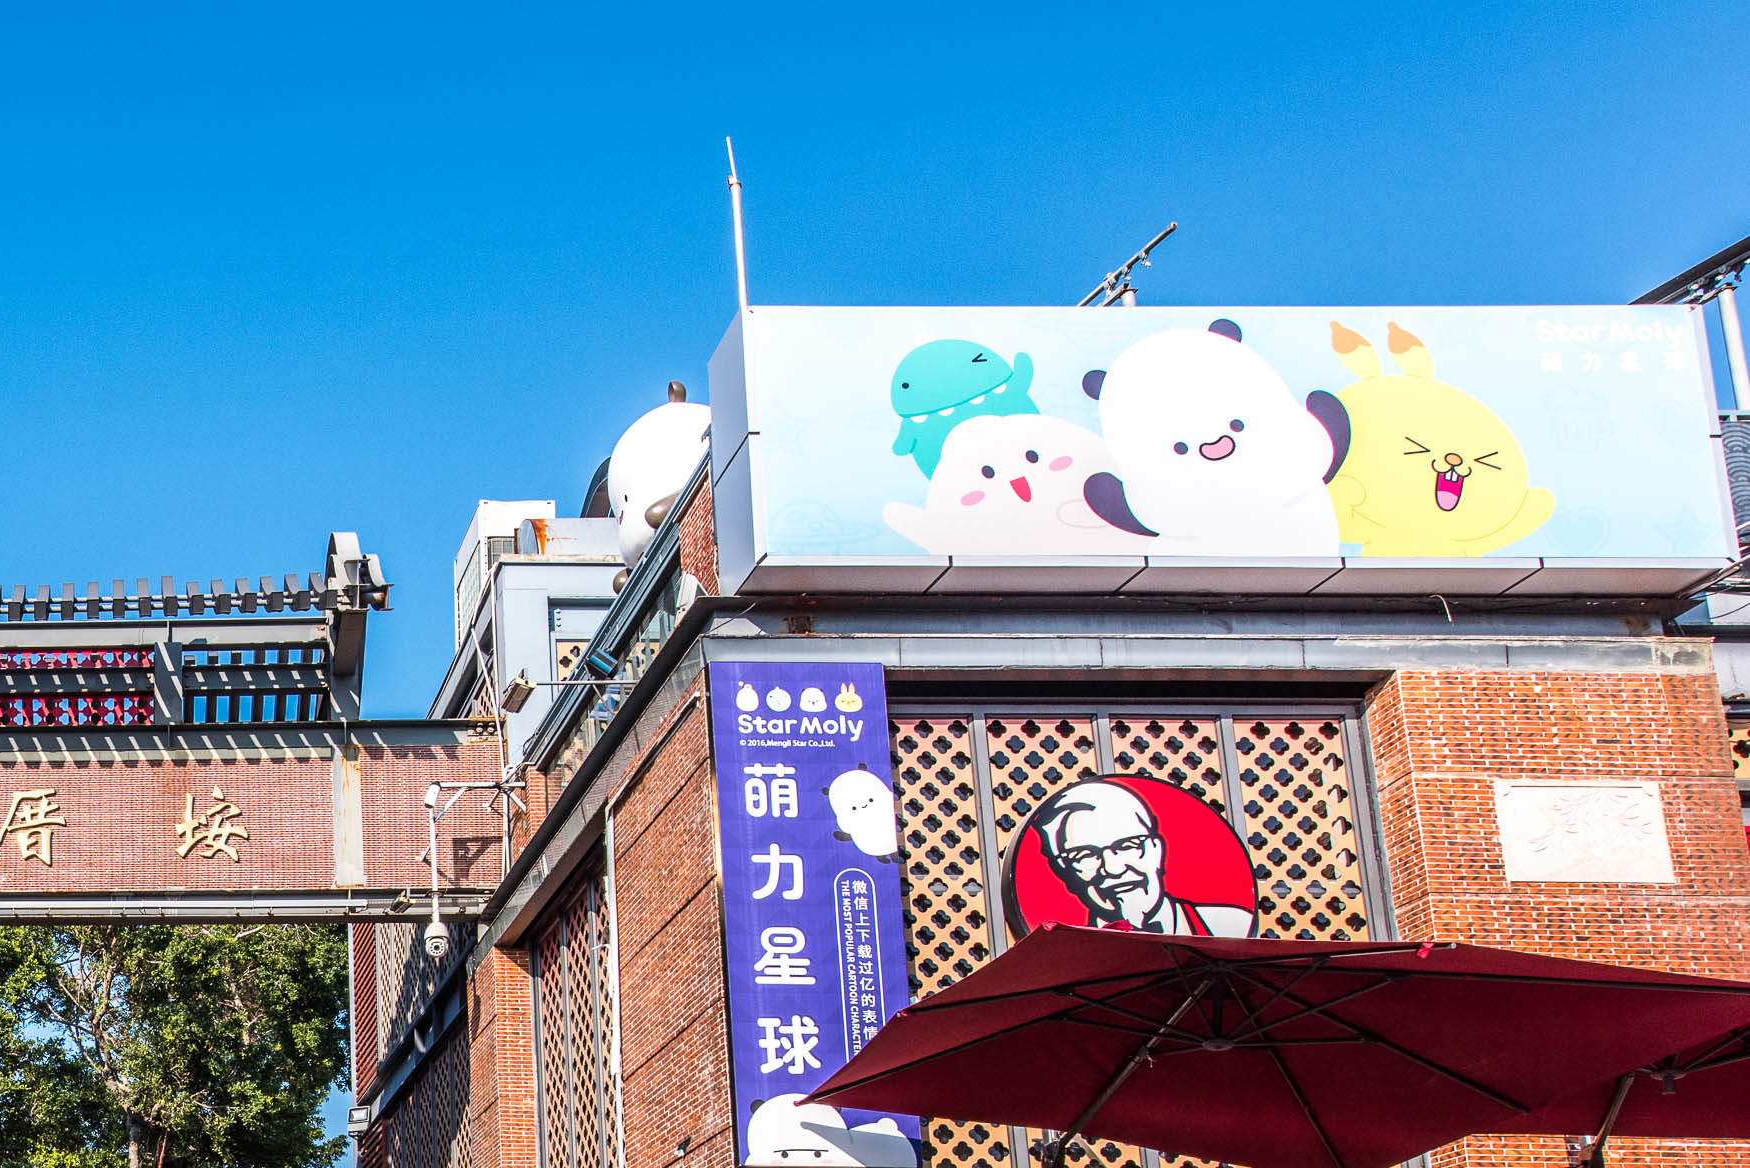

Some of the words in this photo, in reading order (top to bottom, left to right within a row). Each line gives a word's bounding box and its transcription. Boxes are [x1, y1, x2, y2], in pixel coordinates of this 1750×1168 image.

[793, 739, 806, 747] Star
[841, 880, 851, 897] THE
[743, 762, 822, 1075] 萌力星球
[842, 899, 852, 922] MOST
[844, 924, 856, 963] POPULAR
[852, 880, 879, 1041] 微信上下载过亿的表情
[847, 964, 858, 1005] CARTOON
